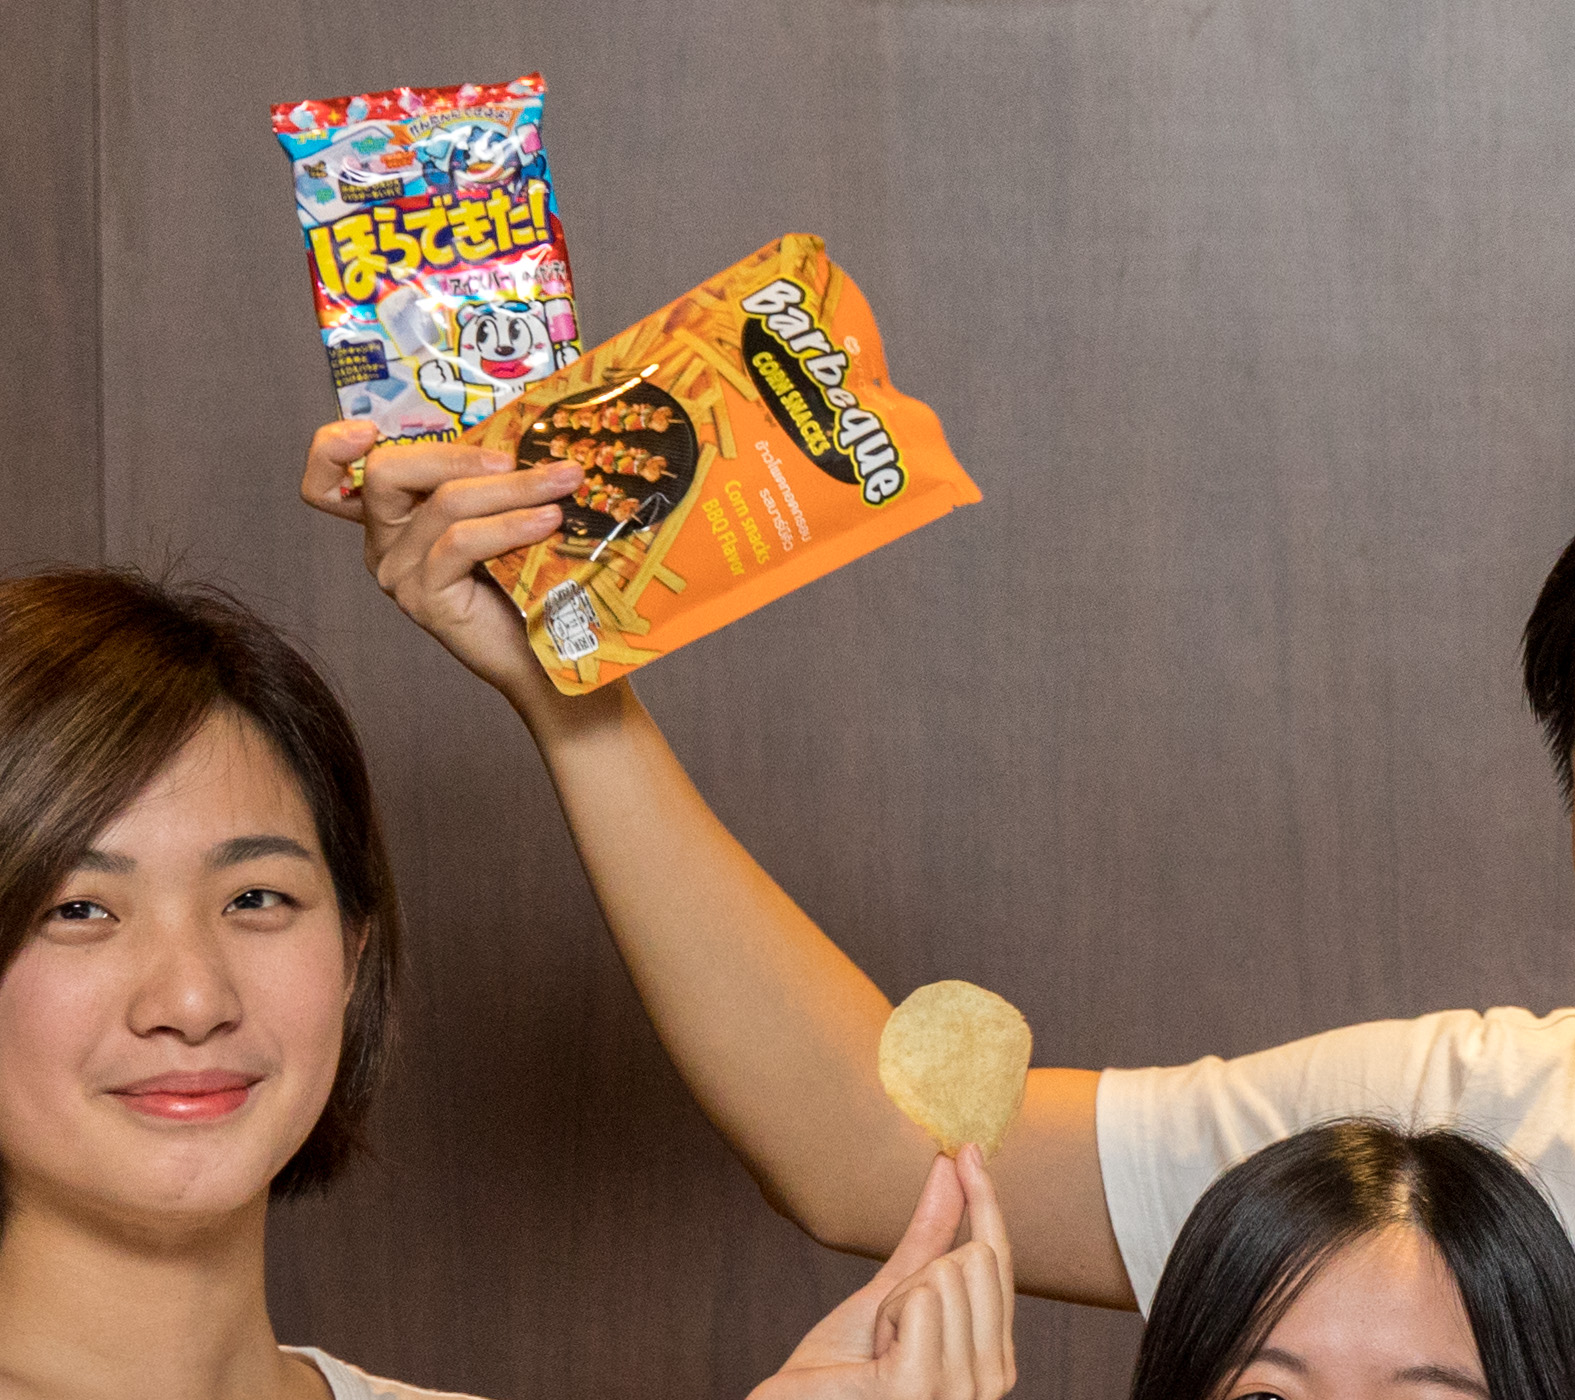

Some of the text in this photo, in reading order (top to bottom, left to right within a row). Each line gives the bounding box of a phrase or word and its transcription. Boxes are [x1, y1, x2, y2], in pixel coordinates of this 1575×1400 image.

[309, 178, 550, 301] ほらできた!
[741, 278, 902, 504] Barbeque
[752, 351, 832, 456] CORN SNACKS
[702, 498, 745, 576] BBQ Flavor
[725, 480, 771, 564] Corn snacks
